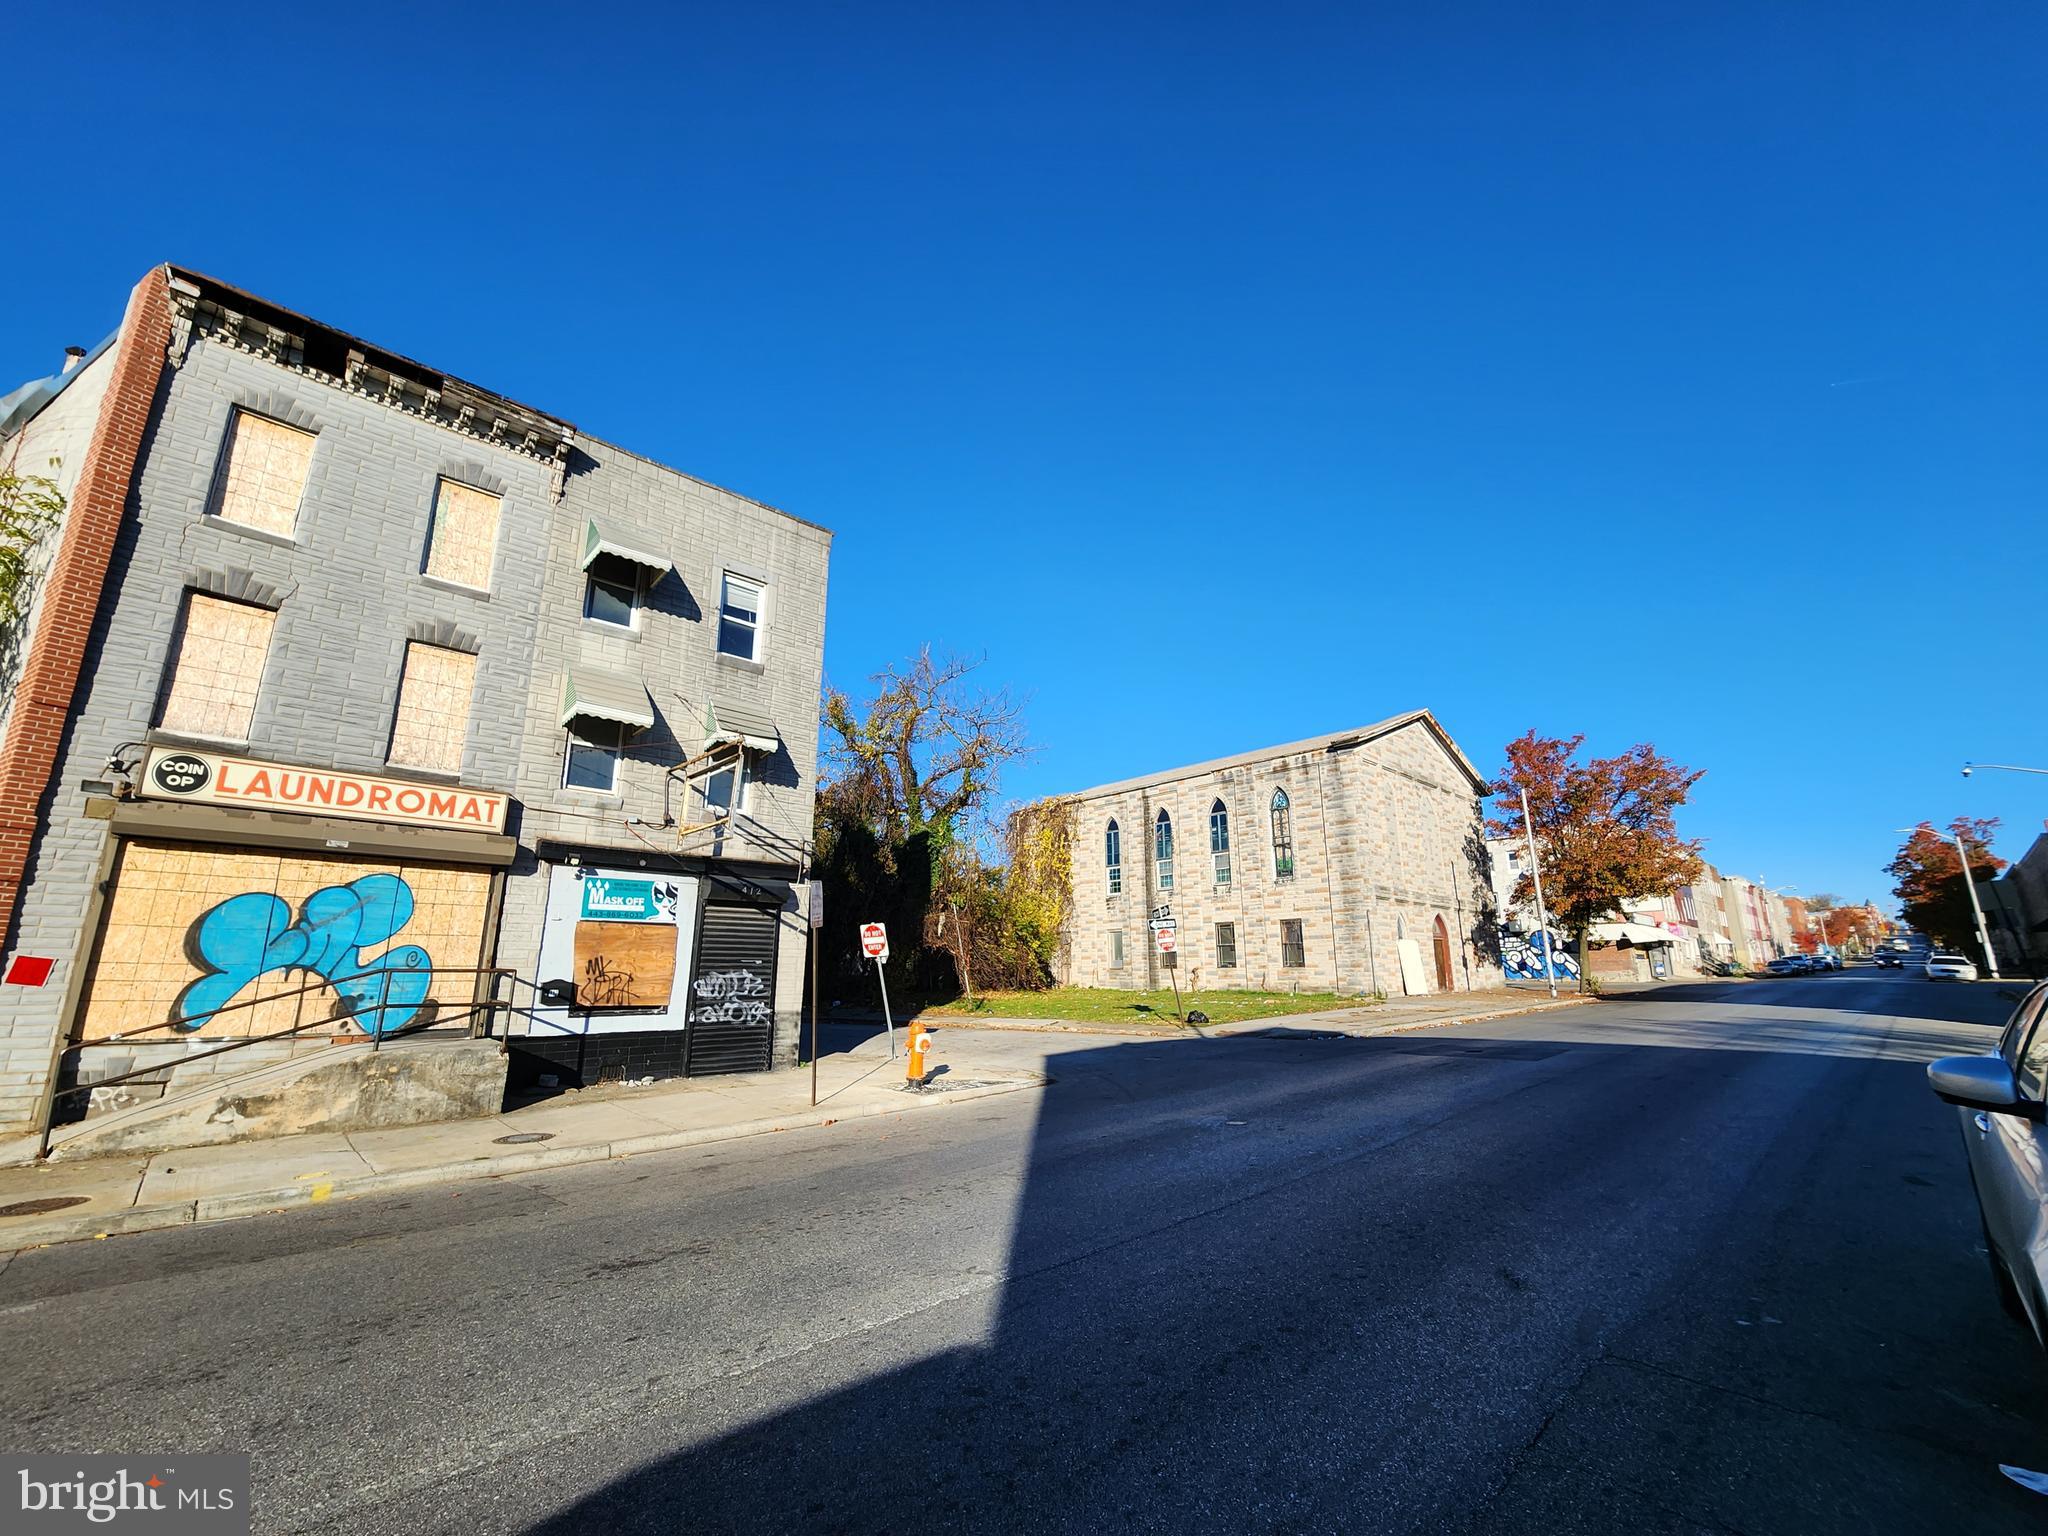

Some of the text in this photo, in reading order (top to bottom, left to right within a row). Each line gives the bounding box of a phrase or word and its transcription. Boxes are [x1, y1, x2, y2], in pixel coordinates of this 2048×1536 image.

[161, 760, 205, 776] COIN
[166, 774, 195, 787] OP
[215, 765, 500, 823] LAUNDROMAT
[589, 886, 624, 905] MASK
[625, 896, 645, 906] OFF
[741, 886, 761, 895] 412
[864, 930, 872, 938] DO
